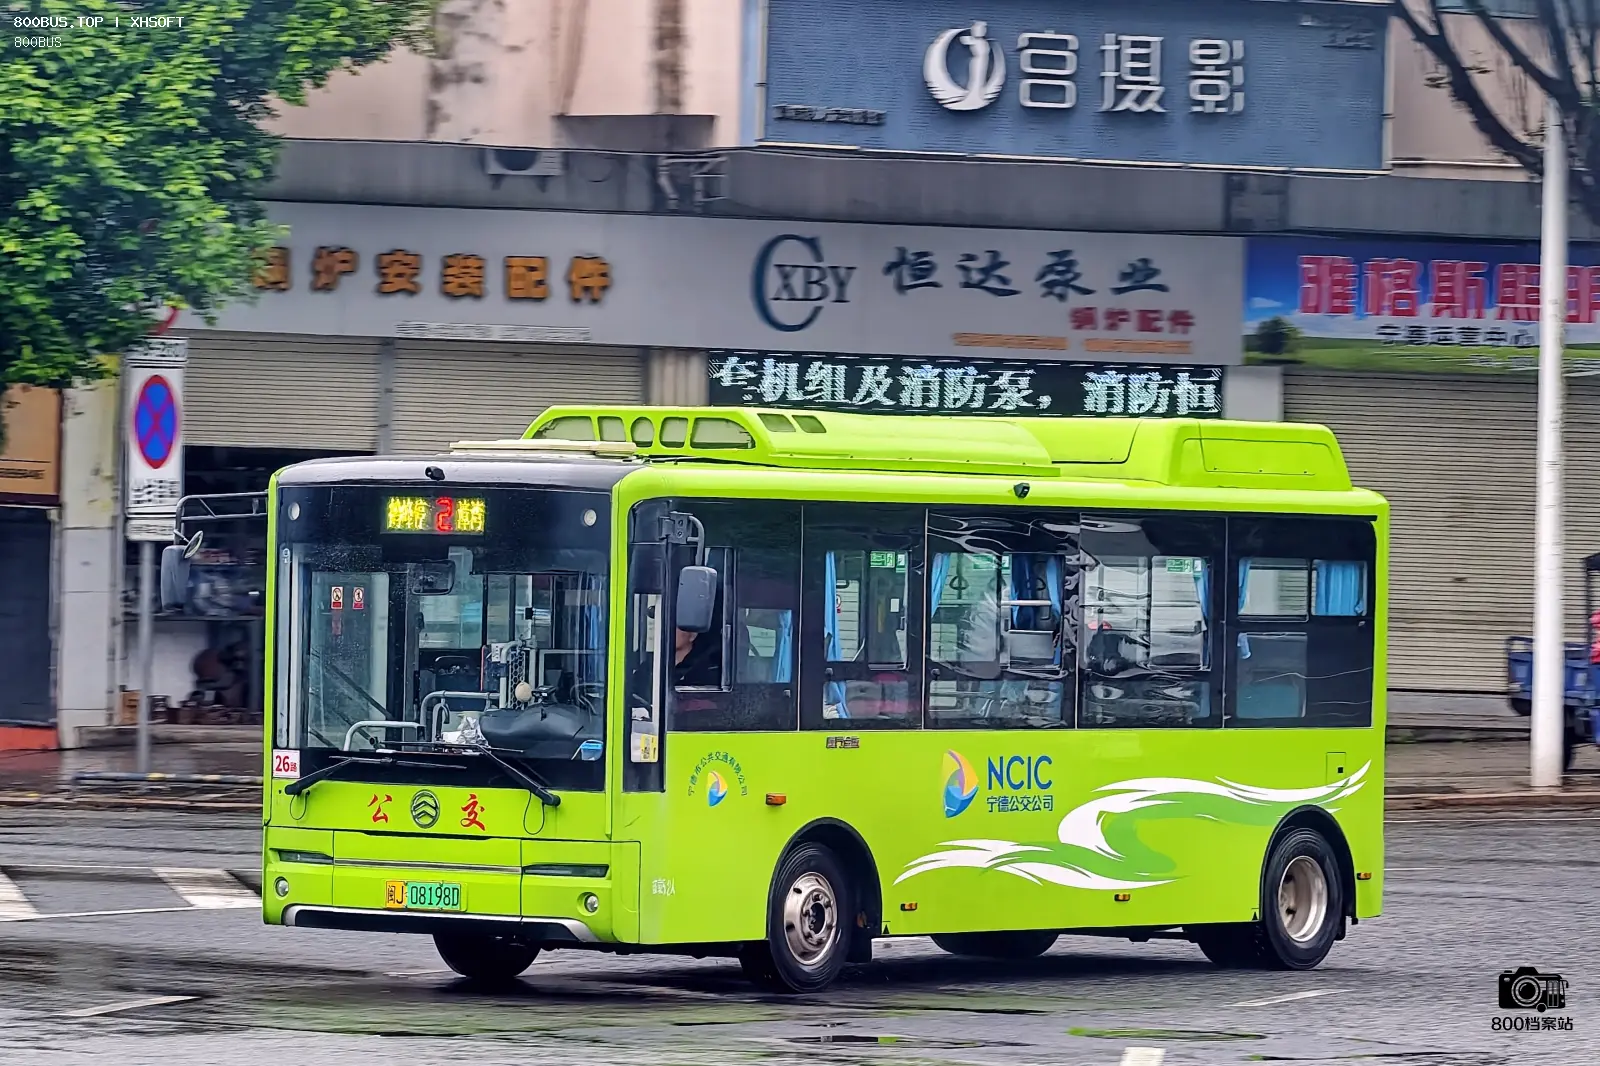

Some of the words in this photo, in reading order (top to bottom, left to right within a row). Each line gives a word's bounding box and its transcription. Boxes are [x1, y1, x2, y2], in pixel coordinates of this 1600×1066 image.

[882, 245, 1171, 303] 恒达泵业
[1069, 306, 1196, 334] 锅炉配件
[436, 496, 455, 533] 2
[687, 751, 748, 797] 宁德市公共交通有限公司
[987, 755, 1053, 790] NCIC
[986, 795, 1054, 812] 宁德公交公司
